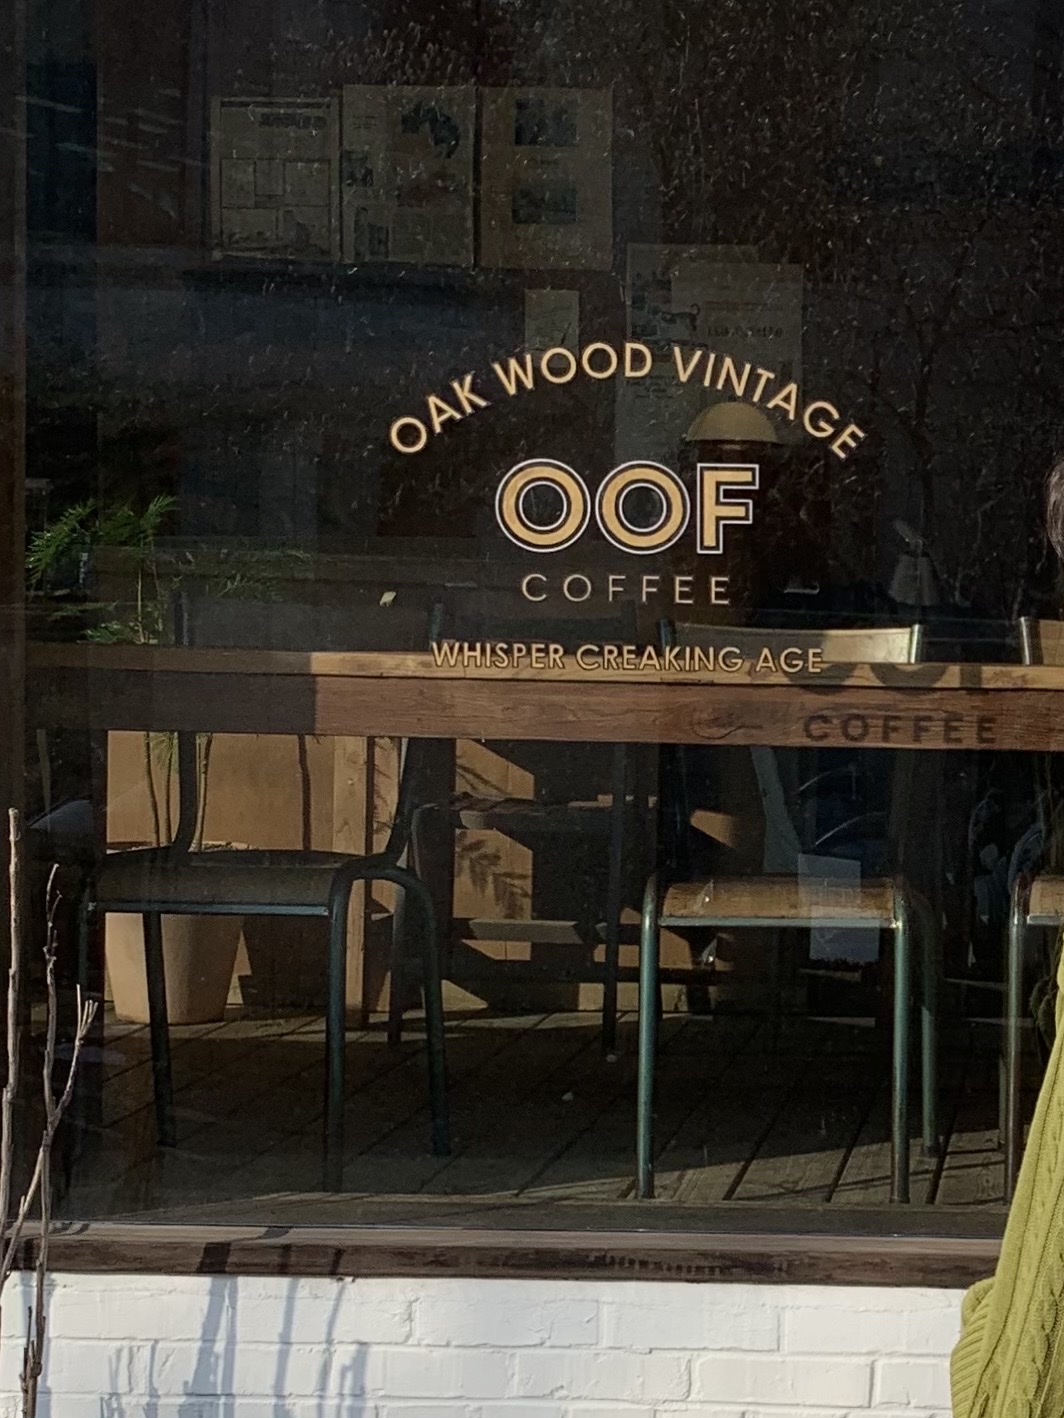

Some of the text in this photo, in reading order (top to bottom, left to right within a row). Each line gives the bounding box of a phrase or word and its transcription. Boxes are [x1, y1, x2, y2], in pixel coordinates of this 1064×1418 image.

[390, 342, 866, 459] OAK WOOD VINTAGE
[495, 458, 760, 554] OOF
[521, 574, 731, 605] COFFEE
[432, 642, 825, 674] WHISPER CREAKING AGE
[803, 715, 997, 744] COFFEE
